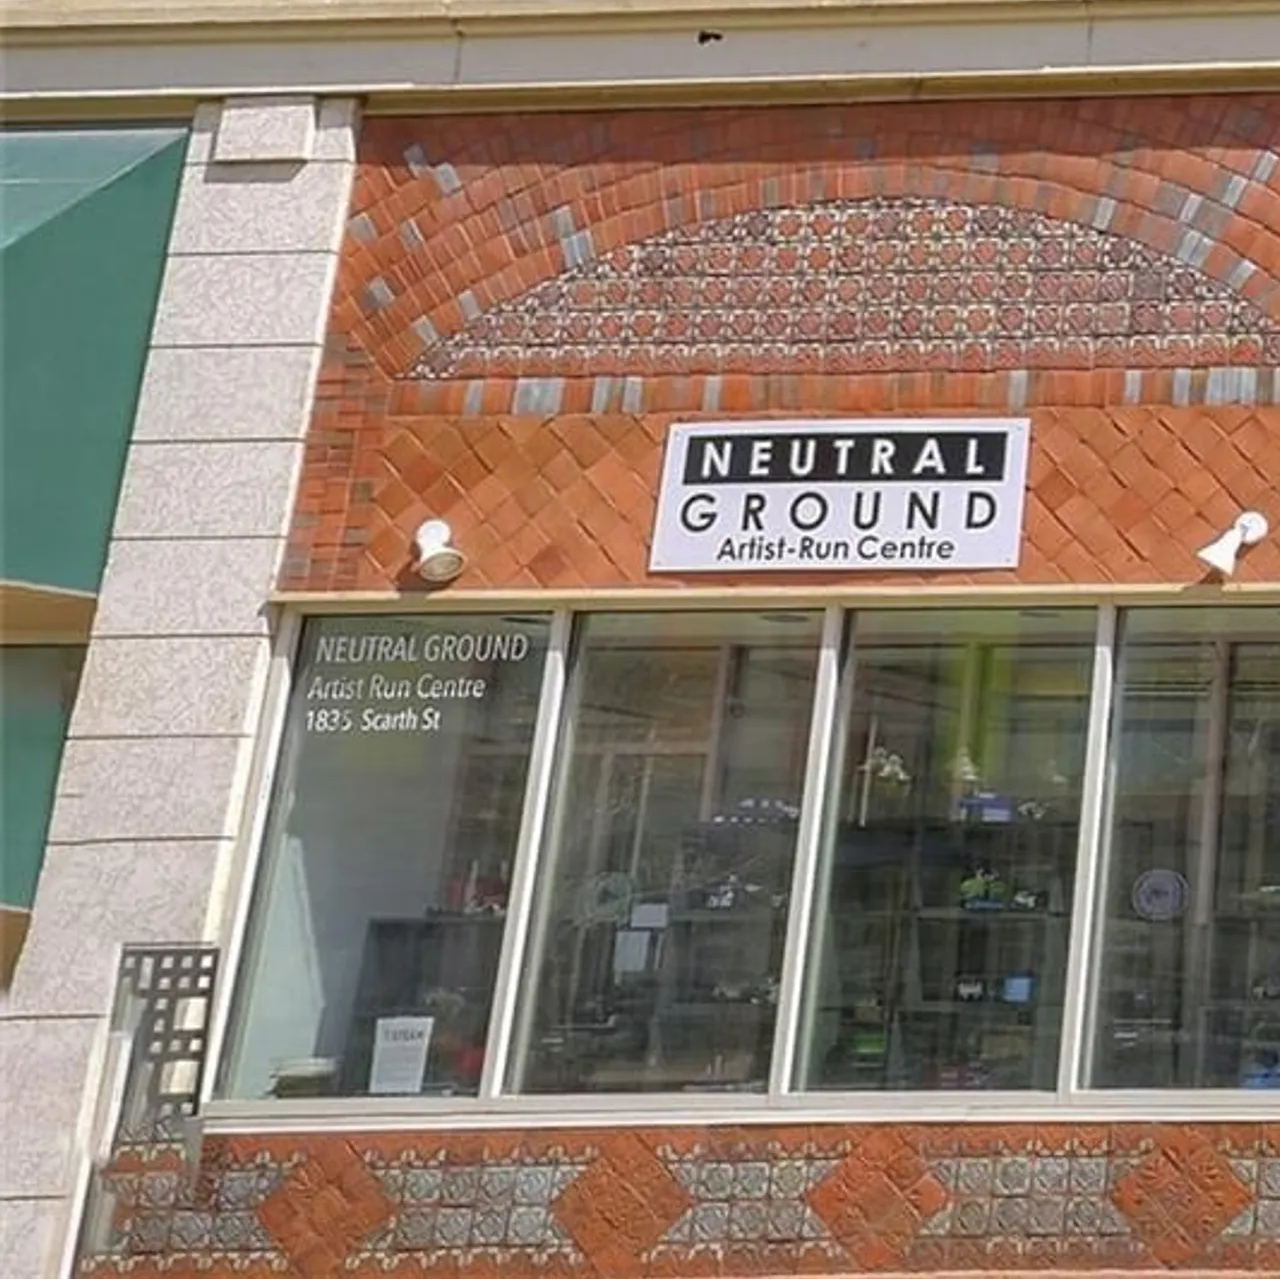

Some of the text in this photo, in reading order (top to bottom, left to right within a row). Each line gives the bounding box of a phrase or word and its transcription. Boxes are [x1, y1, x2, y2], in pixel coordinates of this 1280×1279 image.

[700, 437, 985, 478] NEUTRAL
[681, 491, 998, 532] GROUND
[716, 535, 955, 561] Artist-Run Centre
[315, 633, 529, 663] NEUTRAL GROUND
[307, 673, 487, 700] Artist Run Centre
[307, 707, 441, 733] 1835 Scarth St
